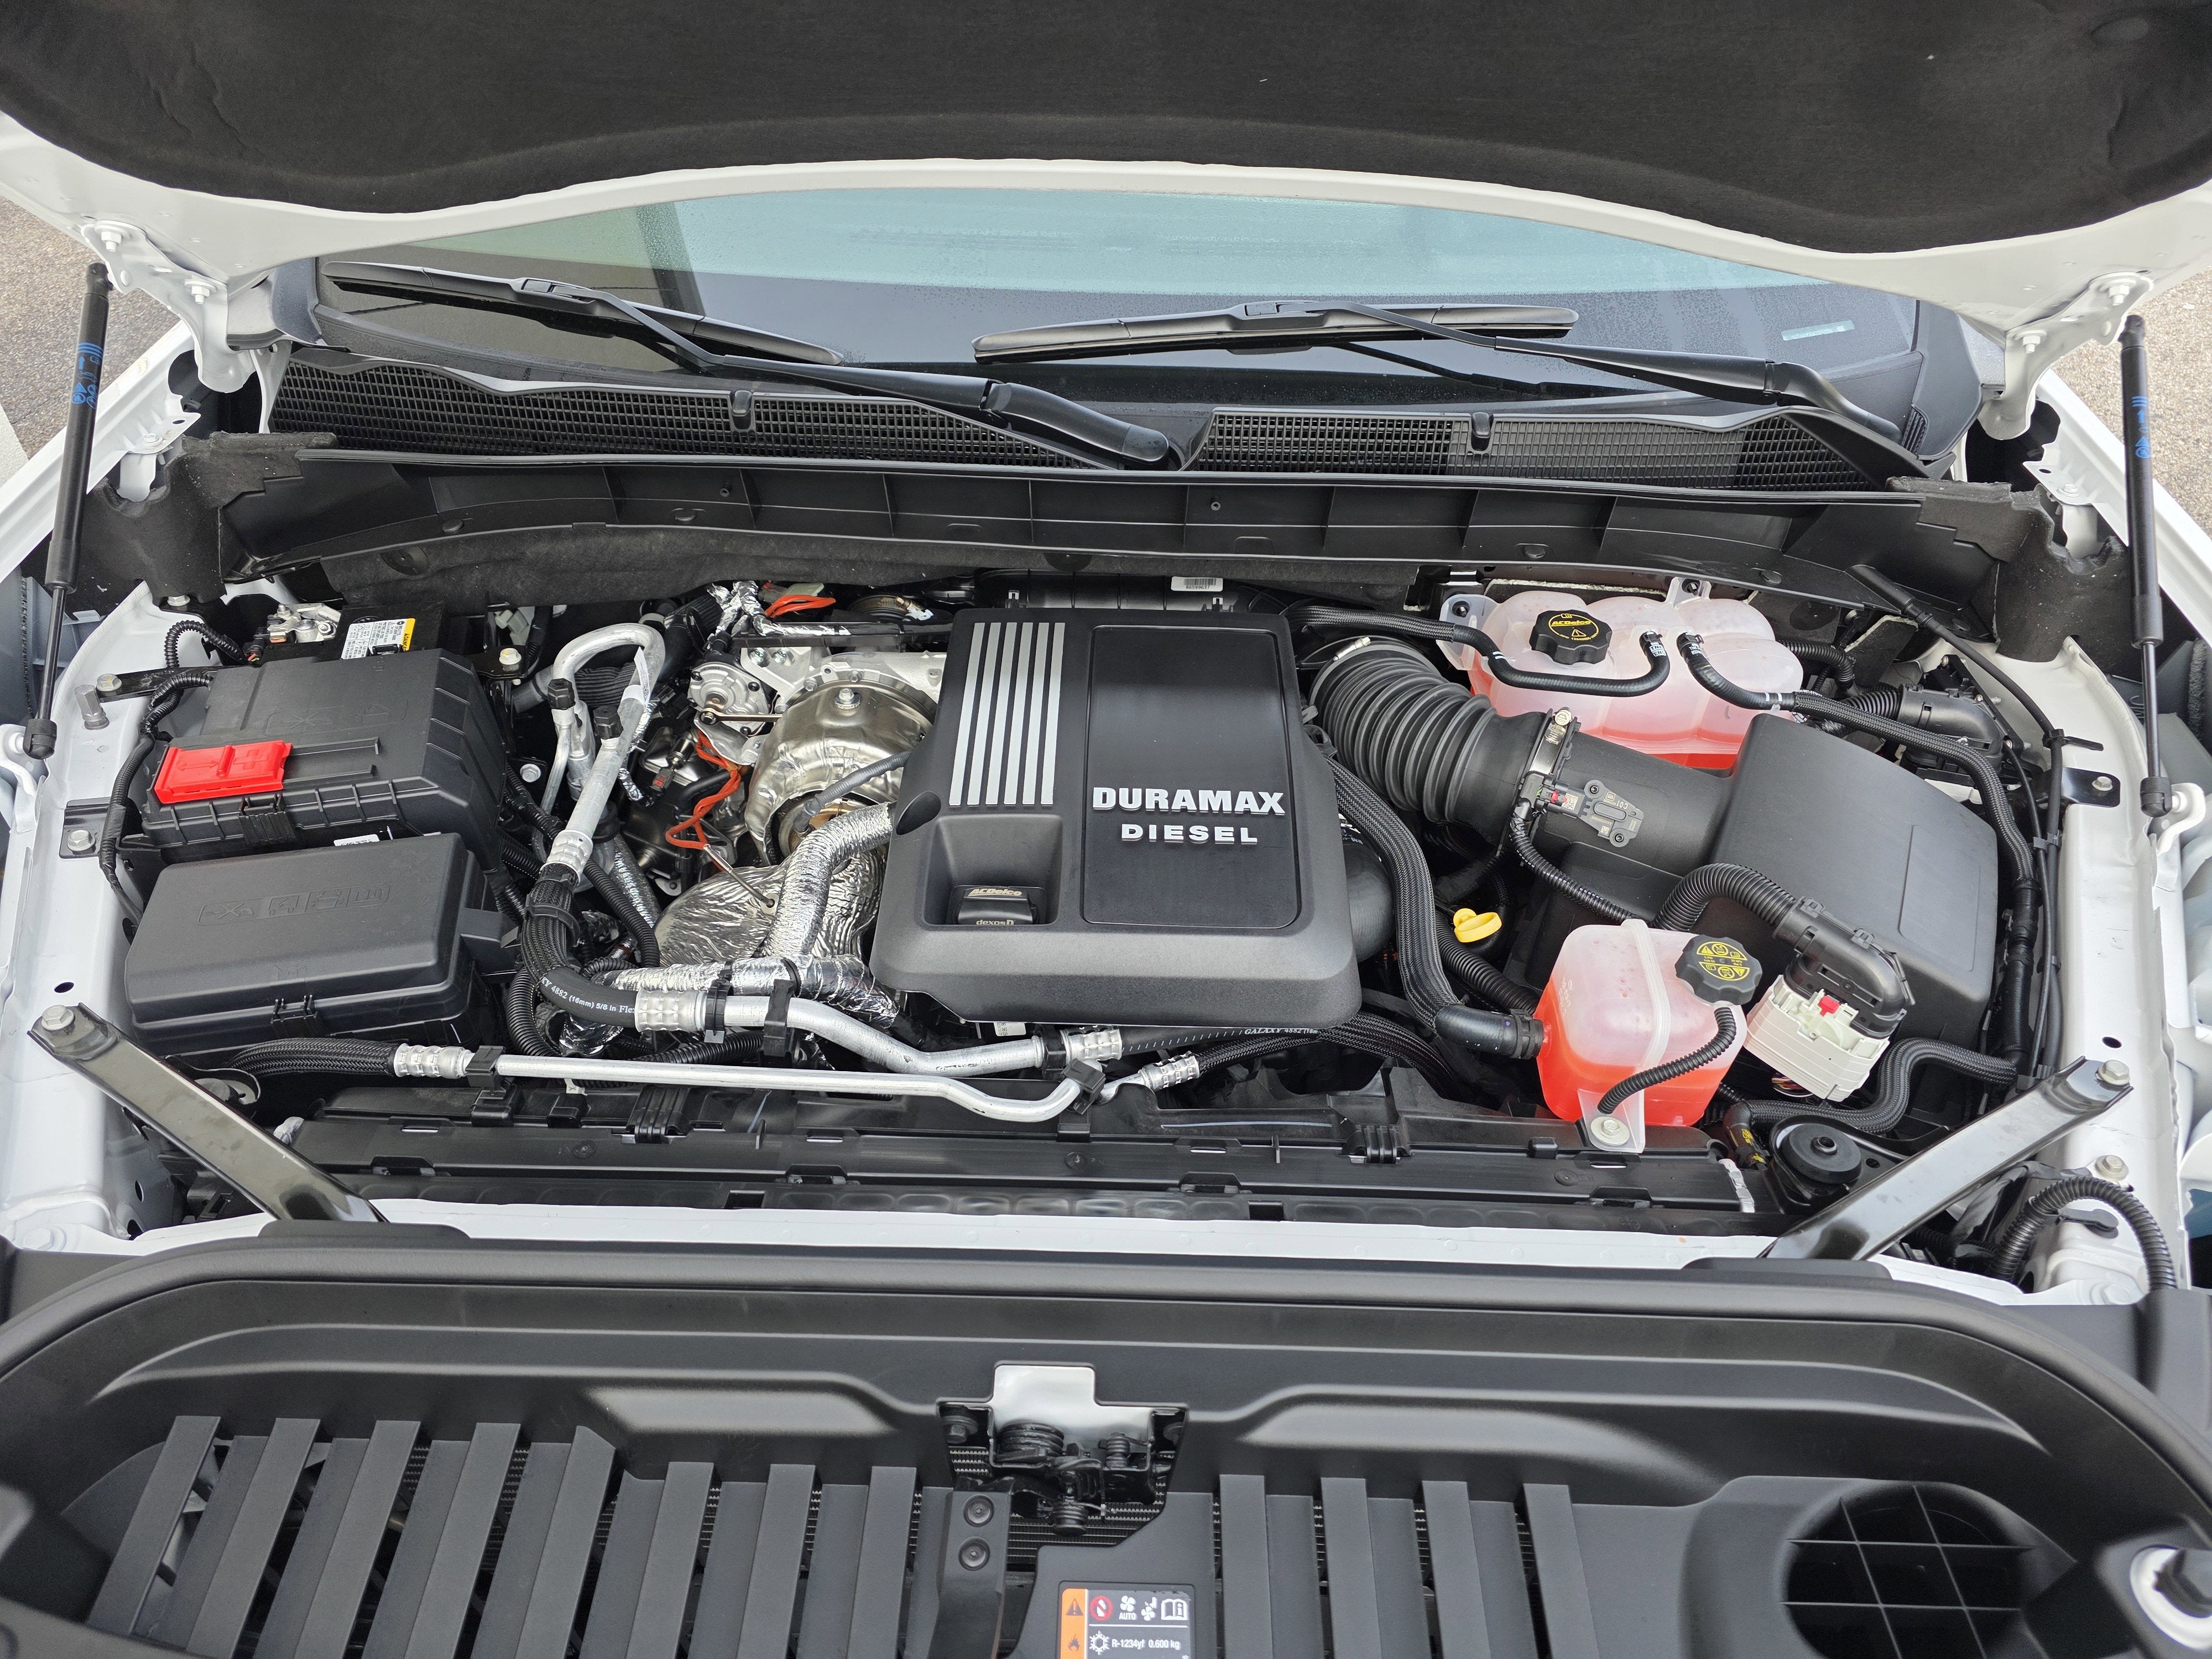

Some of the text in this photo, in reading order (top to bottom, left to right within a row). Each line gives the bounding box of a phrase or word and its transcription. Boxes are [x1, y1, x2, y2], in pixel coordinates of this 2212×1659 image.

[1093, 787, 1285, 816] DURAMAX
[1121, 823, 1258, 844] DIESEL
[968, 888, 1022, 896] ACDelco
[551, 985, 568, 999] 4882
[568, 995, 594, 1009] (16mm)
[1119, 1612, 1137, 1620] AUTO
[1112, 1639, 1182, 1650] R-1234yf 0.600 kg
